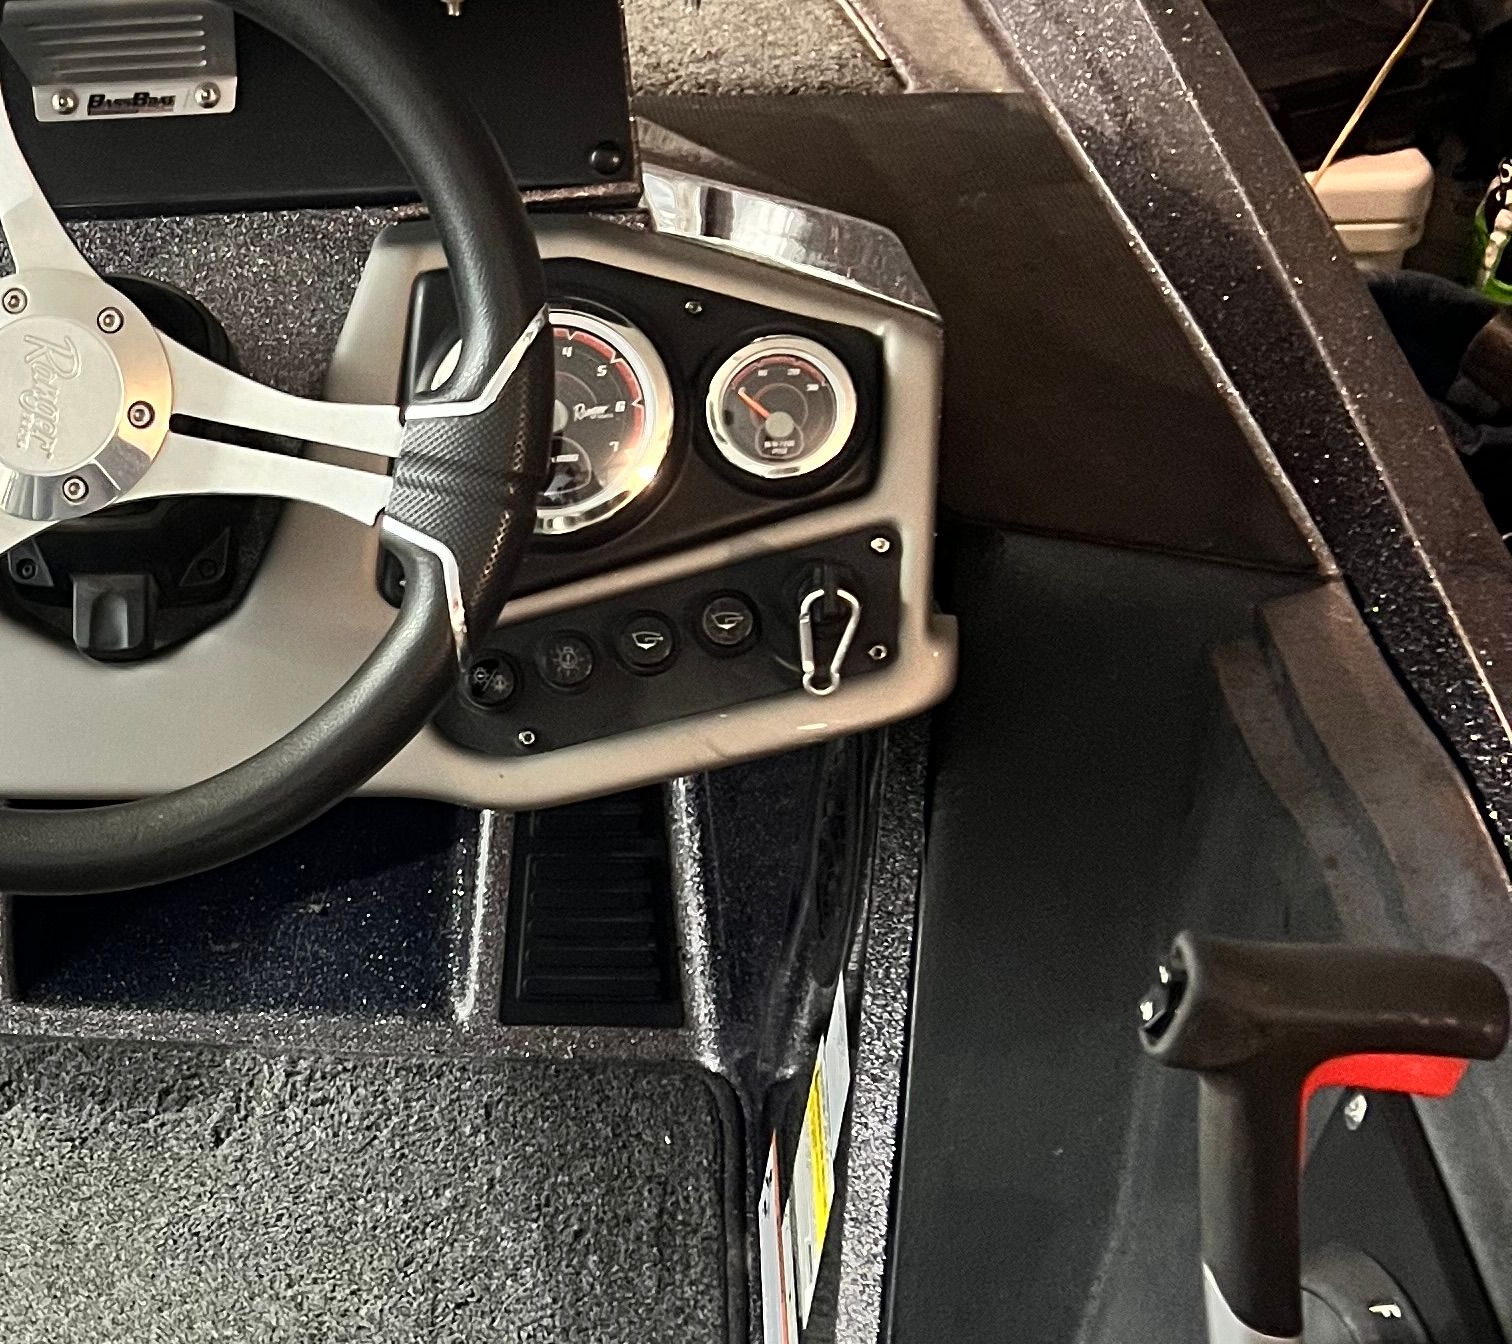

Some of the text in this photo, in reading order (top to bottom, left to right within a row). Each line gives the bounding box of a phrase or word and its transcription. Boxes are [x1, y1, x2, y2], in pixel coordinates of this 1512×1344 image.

[562, 346, 573, 358] 4
[597, 364, 608, 377] 5
[18, 334, 83, 460] Ranger
[614, 400, 626, 413] 6
[609, 440, 620, 452] 7
[1368, 1302, 1402, 1319] F
